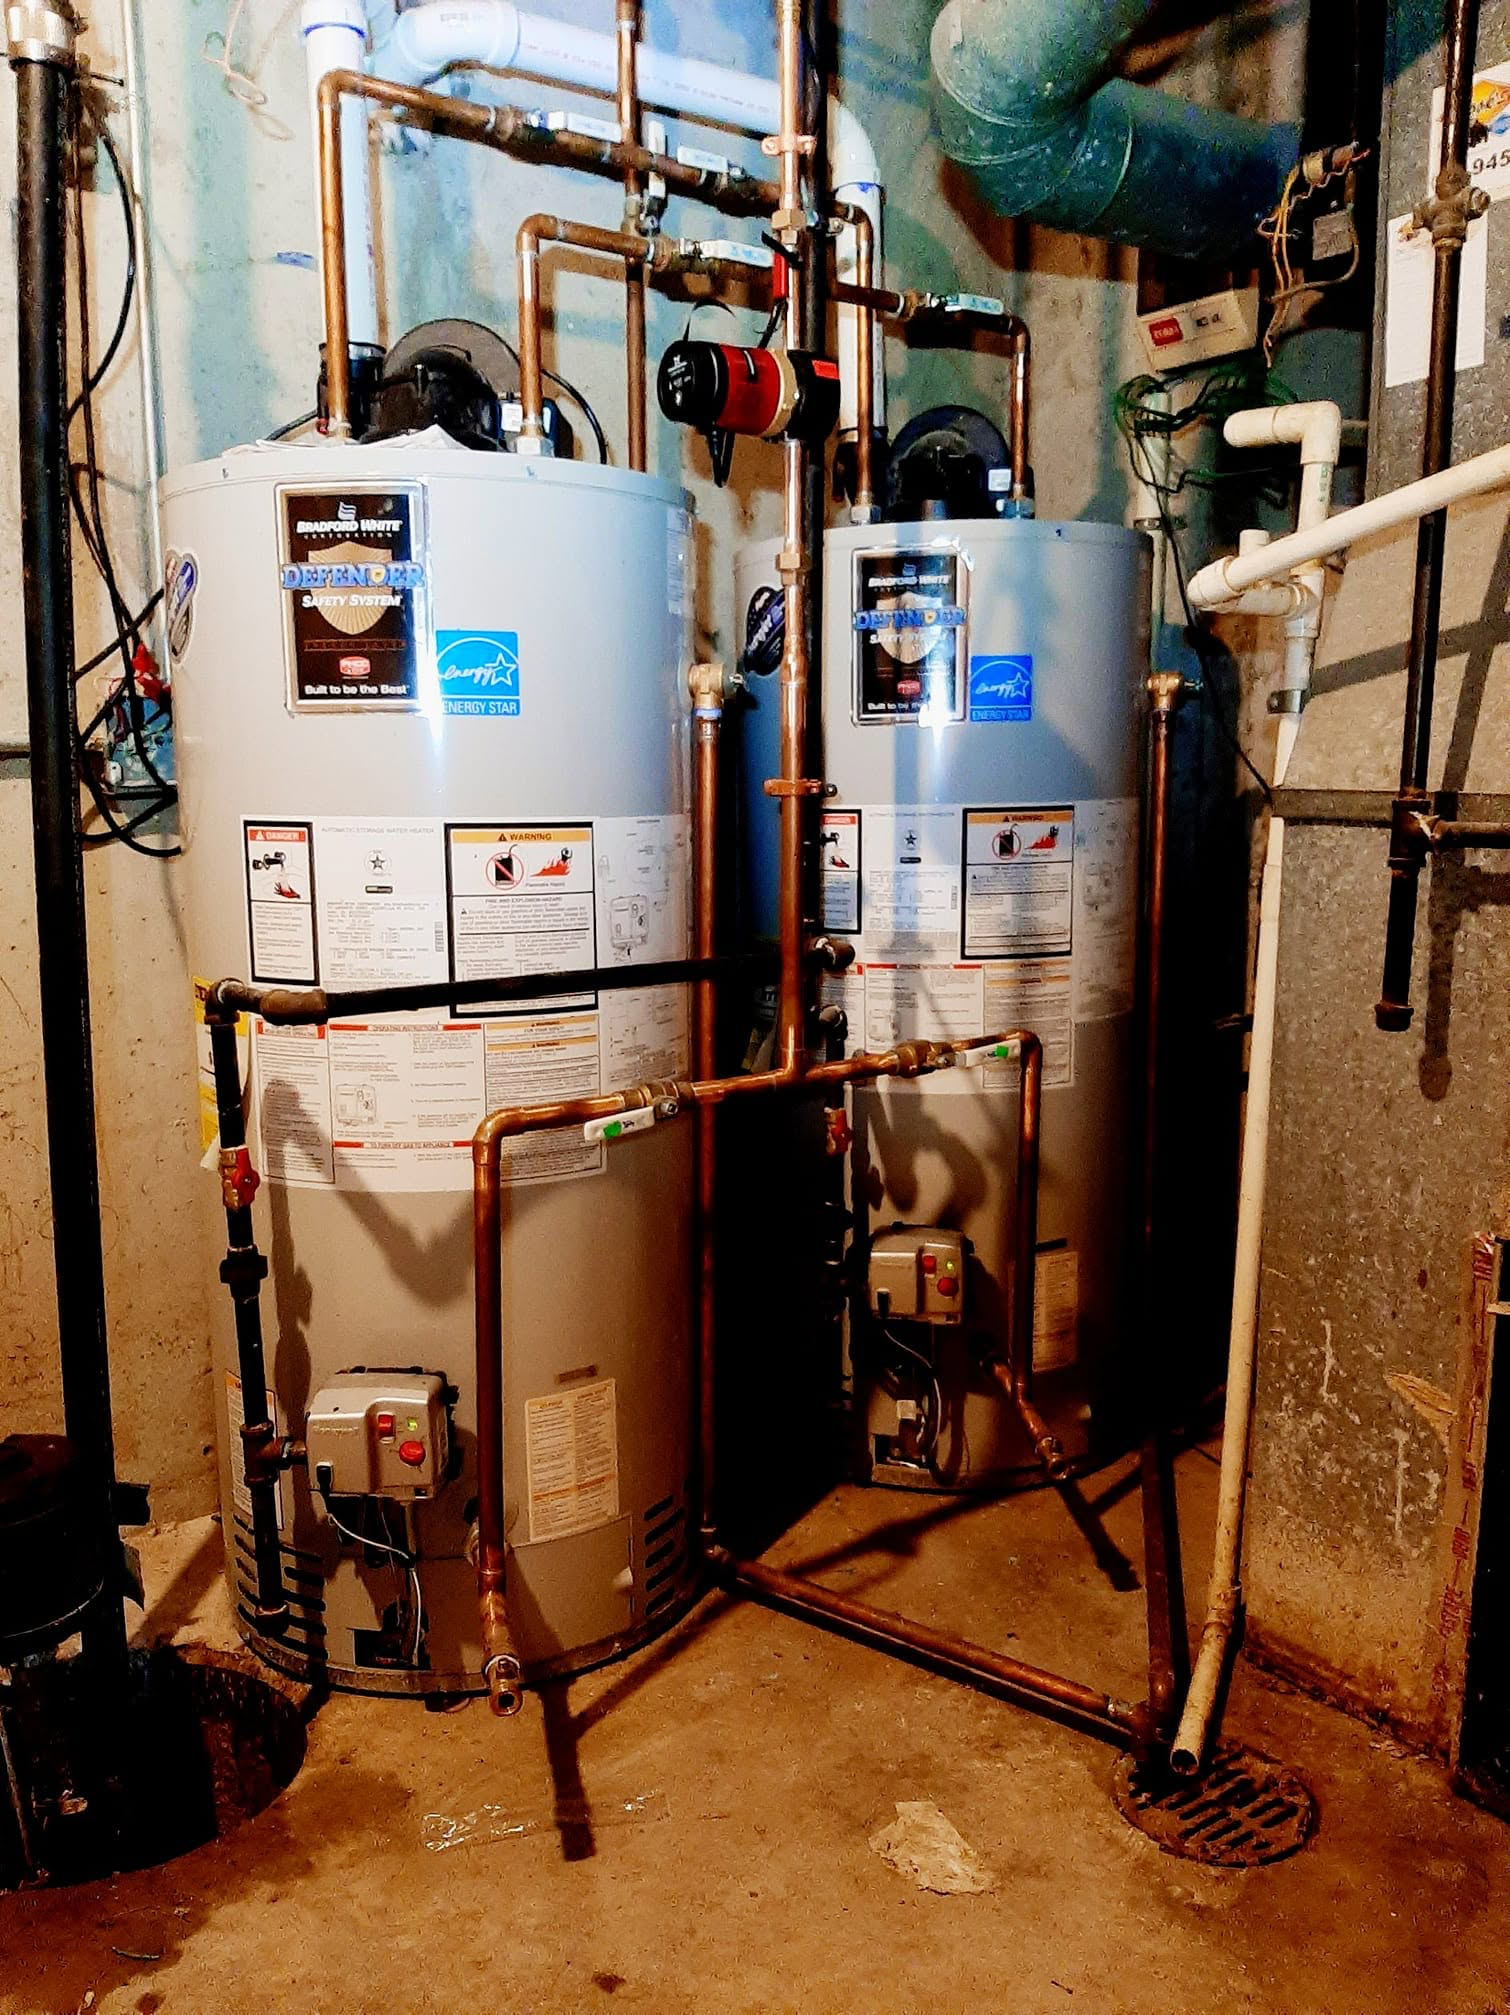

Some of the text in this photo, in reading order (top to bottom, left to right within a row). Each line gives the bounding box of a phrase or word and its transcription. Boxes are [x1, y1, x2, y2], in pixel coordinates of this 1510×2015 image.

[296, 519, 402, 533] BRADFORD WHITE
[282, 561, 425, 588] DEFENDER
[302, 595, 402, 608] SAFETY SYSTEM
[443, 701, 517, 714] ENERGY STAR
[265, 831, 299, 841] DANGER
[510, 833, 552, 841] WARNING
